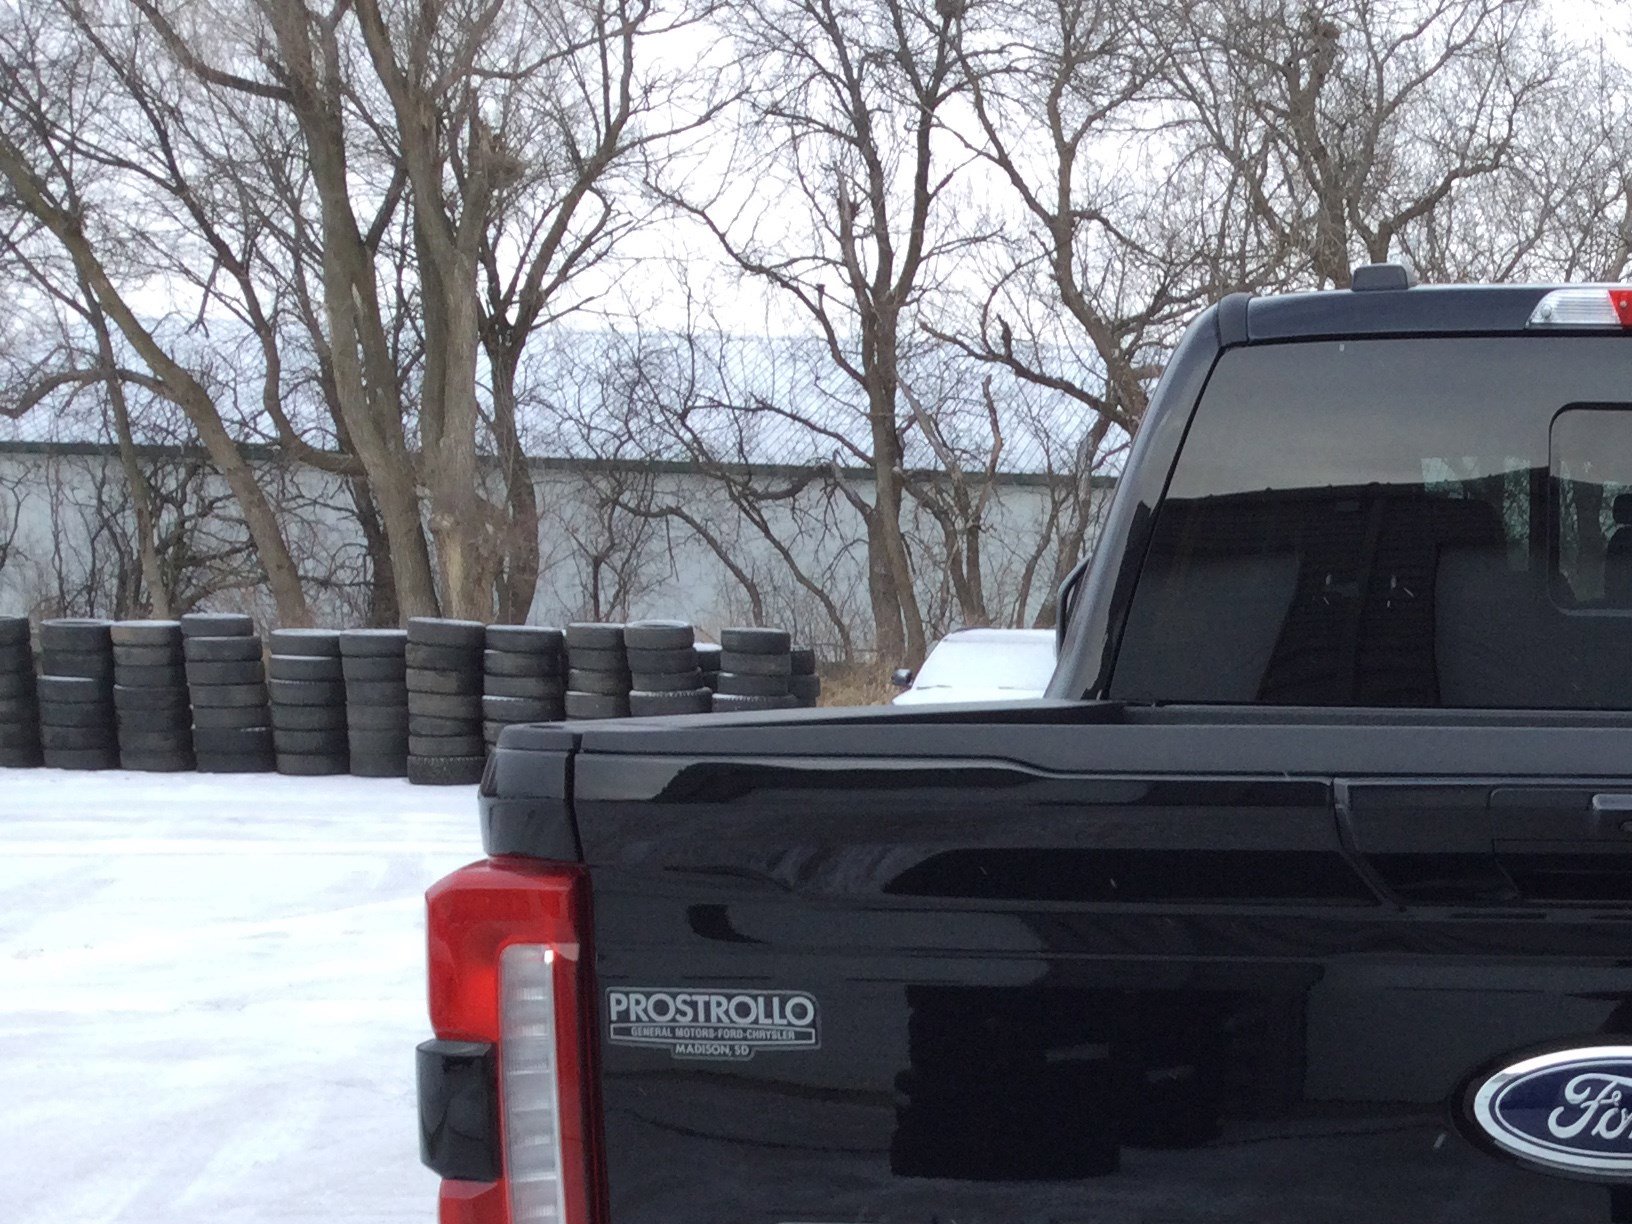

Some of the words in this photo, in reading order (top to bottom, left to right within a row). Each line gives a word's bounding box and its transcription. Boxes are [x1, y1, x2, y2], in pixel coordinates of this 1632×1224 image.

[609, 992, 815, 1026] PROSTROLLO
[630, 1026, 673, 1038] GENERAL
[734, 1044, 750, 1055] SD
